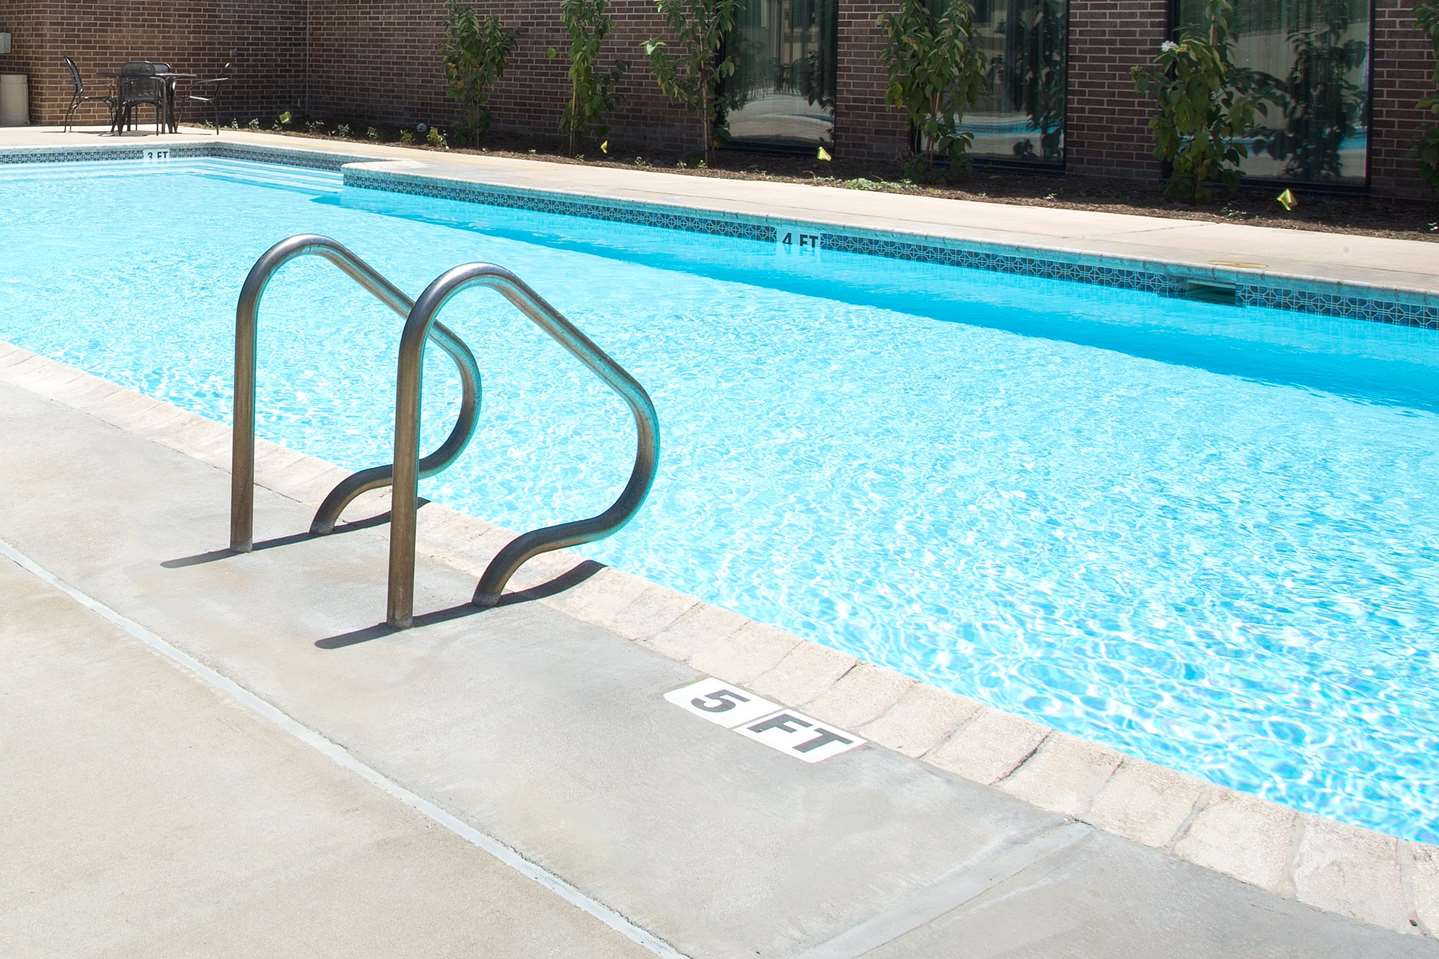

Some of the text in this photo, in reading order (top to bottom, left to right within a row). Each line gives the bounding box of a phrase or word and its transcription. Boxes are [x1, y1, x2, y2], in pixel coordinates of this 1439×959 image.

[156, 151, 169, 159] FT
[782, 232, 819, 249] 4 FT
[690, 689, 854, 754] 5 FT
